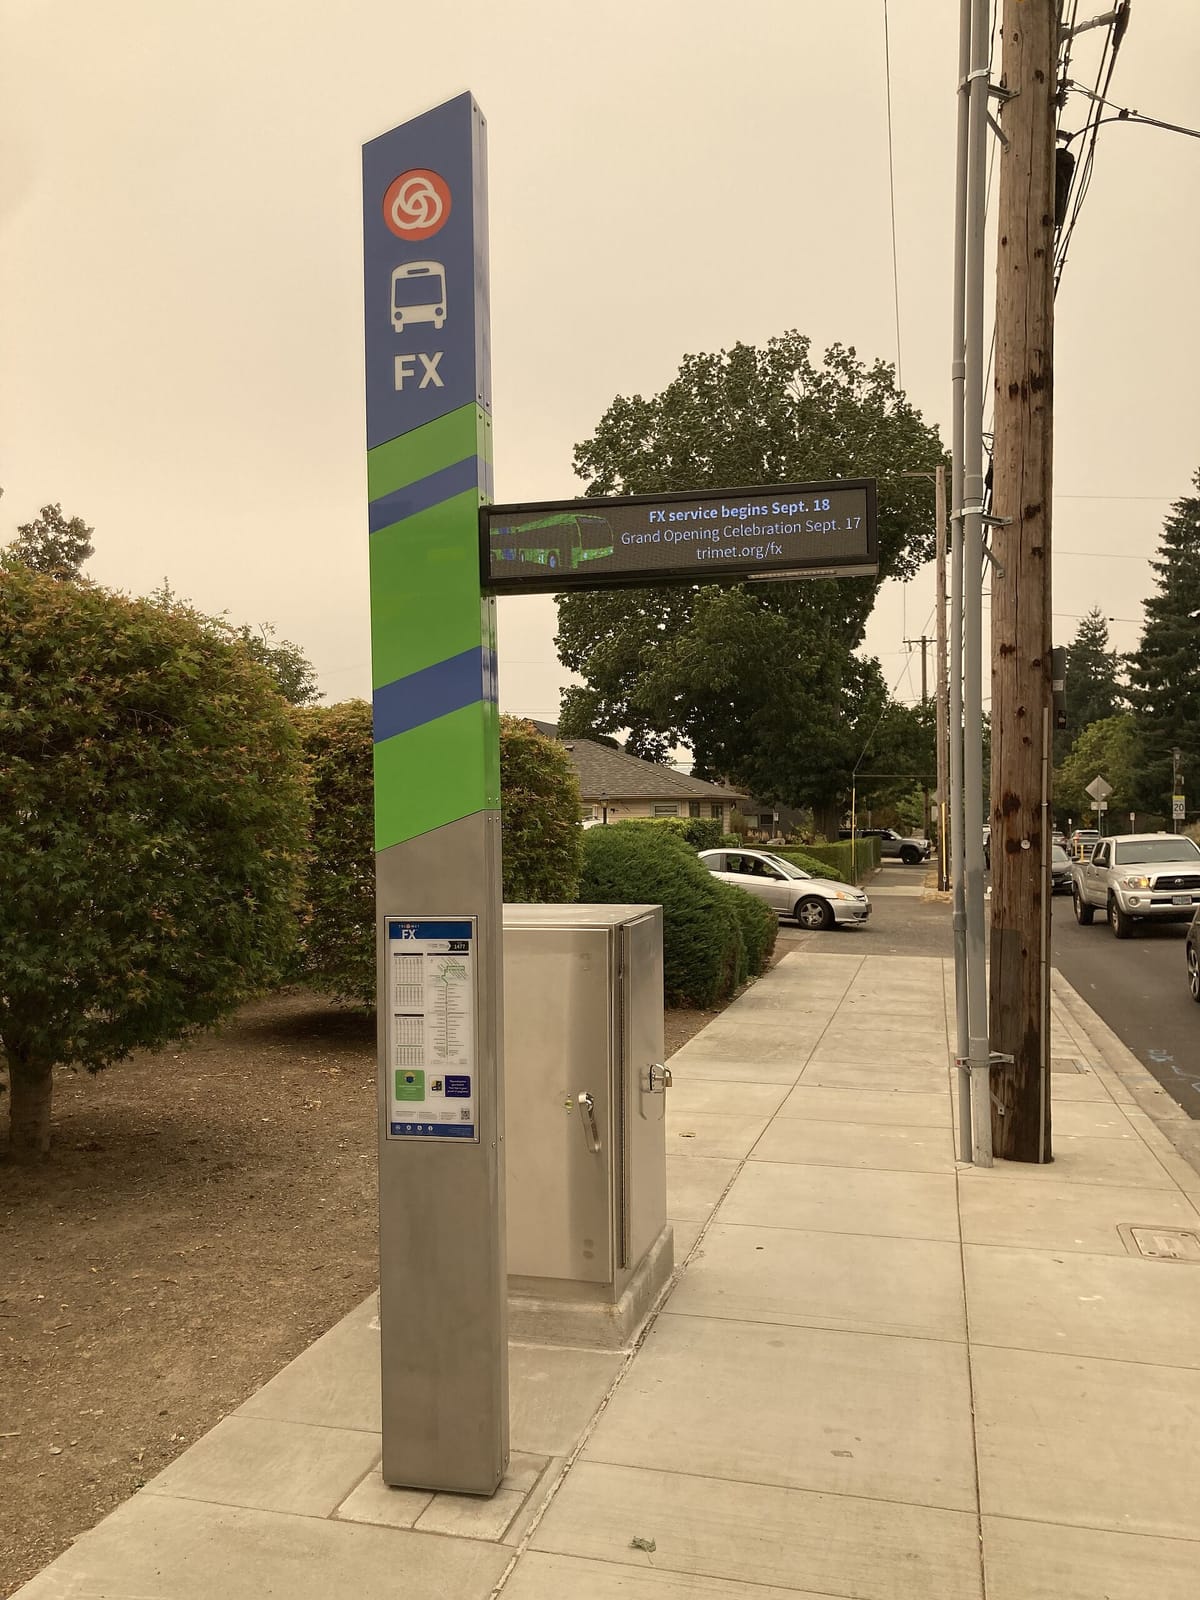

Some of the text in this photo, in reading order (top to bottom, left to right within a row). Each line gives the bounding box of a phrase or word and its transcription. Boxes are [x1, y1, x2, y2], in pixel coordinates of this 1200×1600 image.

[394, 352, 444, 391] FX
[649, 498, 831, 523] FX service begins Sept. 18
[621, 517, 861, 545] Grand Opening Celebration Sept. 17
[696, 541, 783, 560] trimet.org/fx
[401, 929, 416, 940] FX
